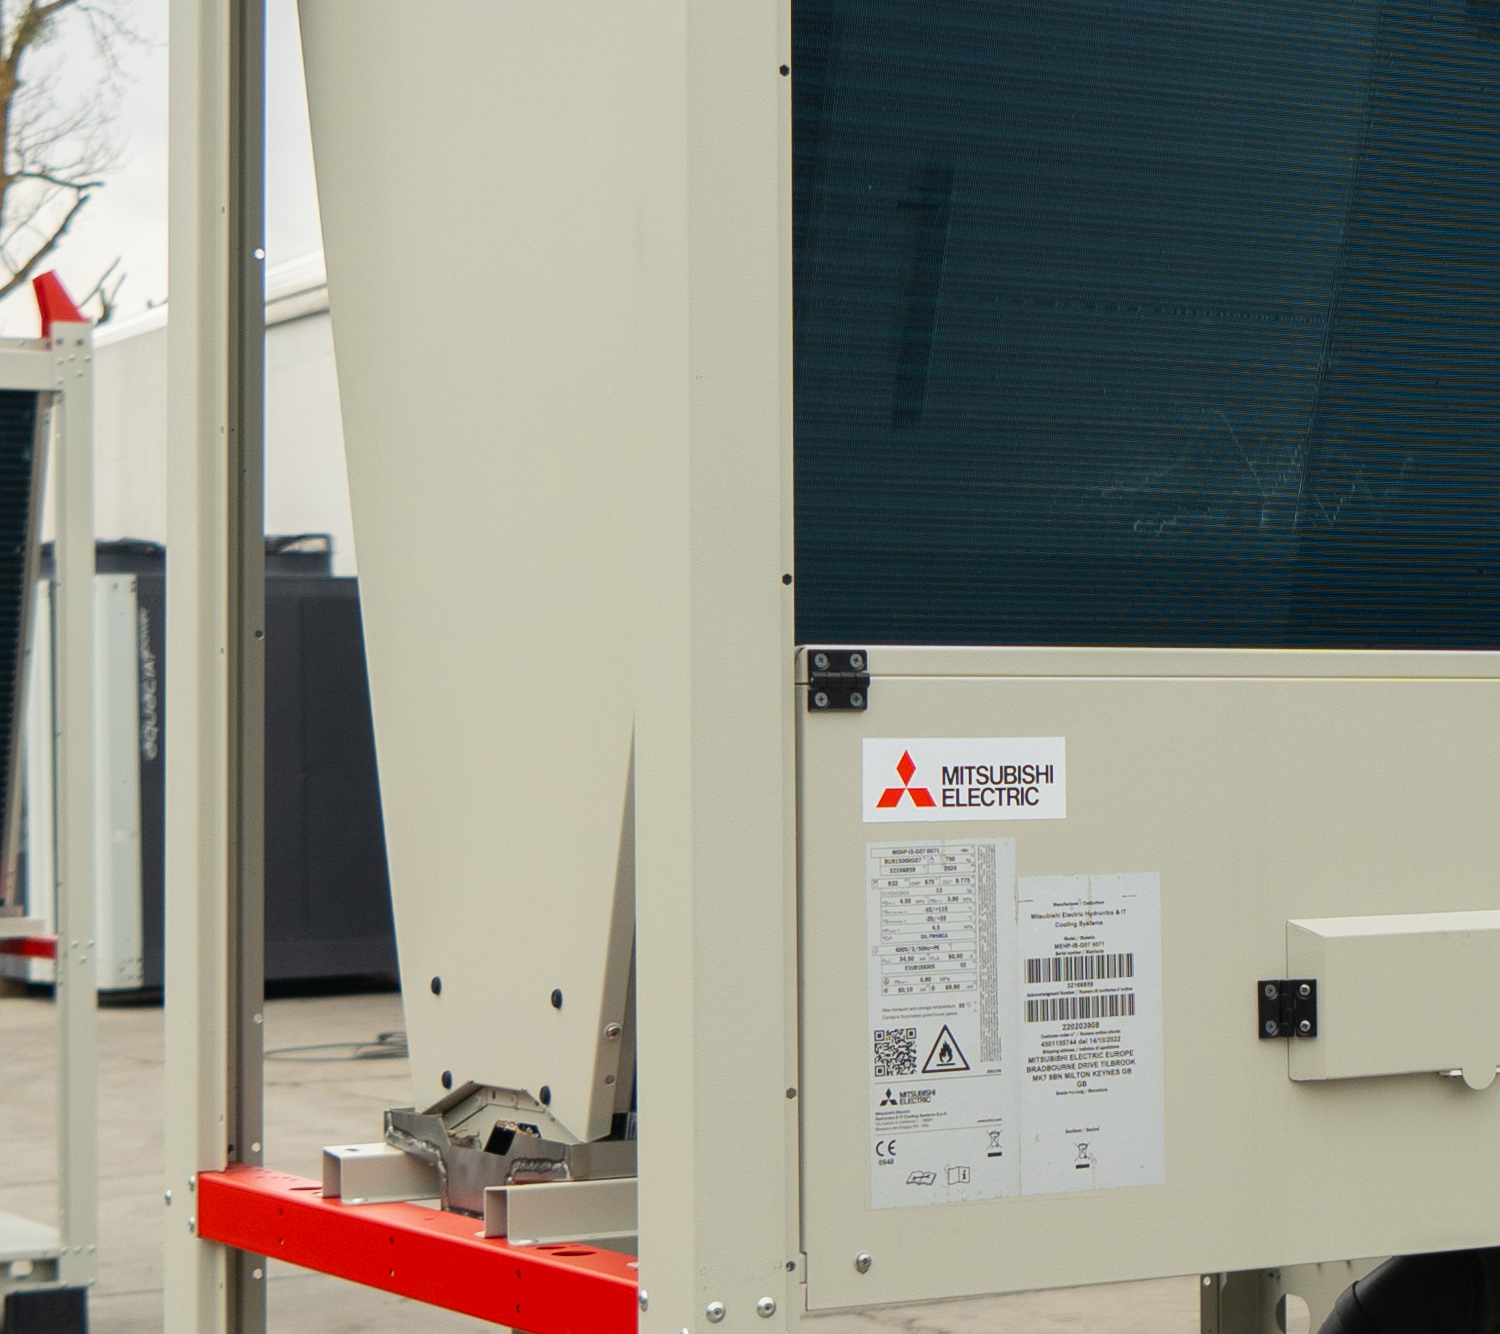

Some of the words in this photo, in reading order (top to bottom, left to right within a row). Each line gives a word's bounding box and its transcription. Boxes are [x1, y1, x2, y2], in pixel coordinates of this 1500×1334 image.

[941, 764, 1054, 786] MITSUBISHI
[941, 787, 1040, 808] ELECTRIC
[1085, 910, 1114, 918] Hydronics
[1028, 1055, 1068, 1064] MITSUBISHI
[1069, 1052, 1104, 1061] ELECTRIC
[1105, 1050, 1134, 1058] EUROPE
[1026, 1063, 1076, 1073] BRADBOURNE
[1078, 1061, 1099, 1069] DRIVE
[1100, 1059, 1136, 1067] TILBROOK
[1032, 1074, 1047, 1082] MK7
[1064, 1071, 1091, 1079] MILTON
[1076, 1080, 1088, 1088] GB
[899, 1089, 936, 1098] MITSUBISHI
[899, 1096, 932, 1105] ELECTRIC
